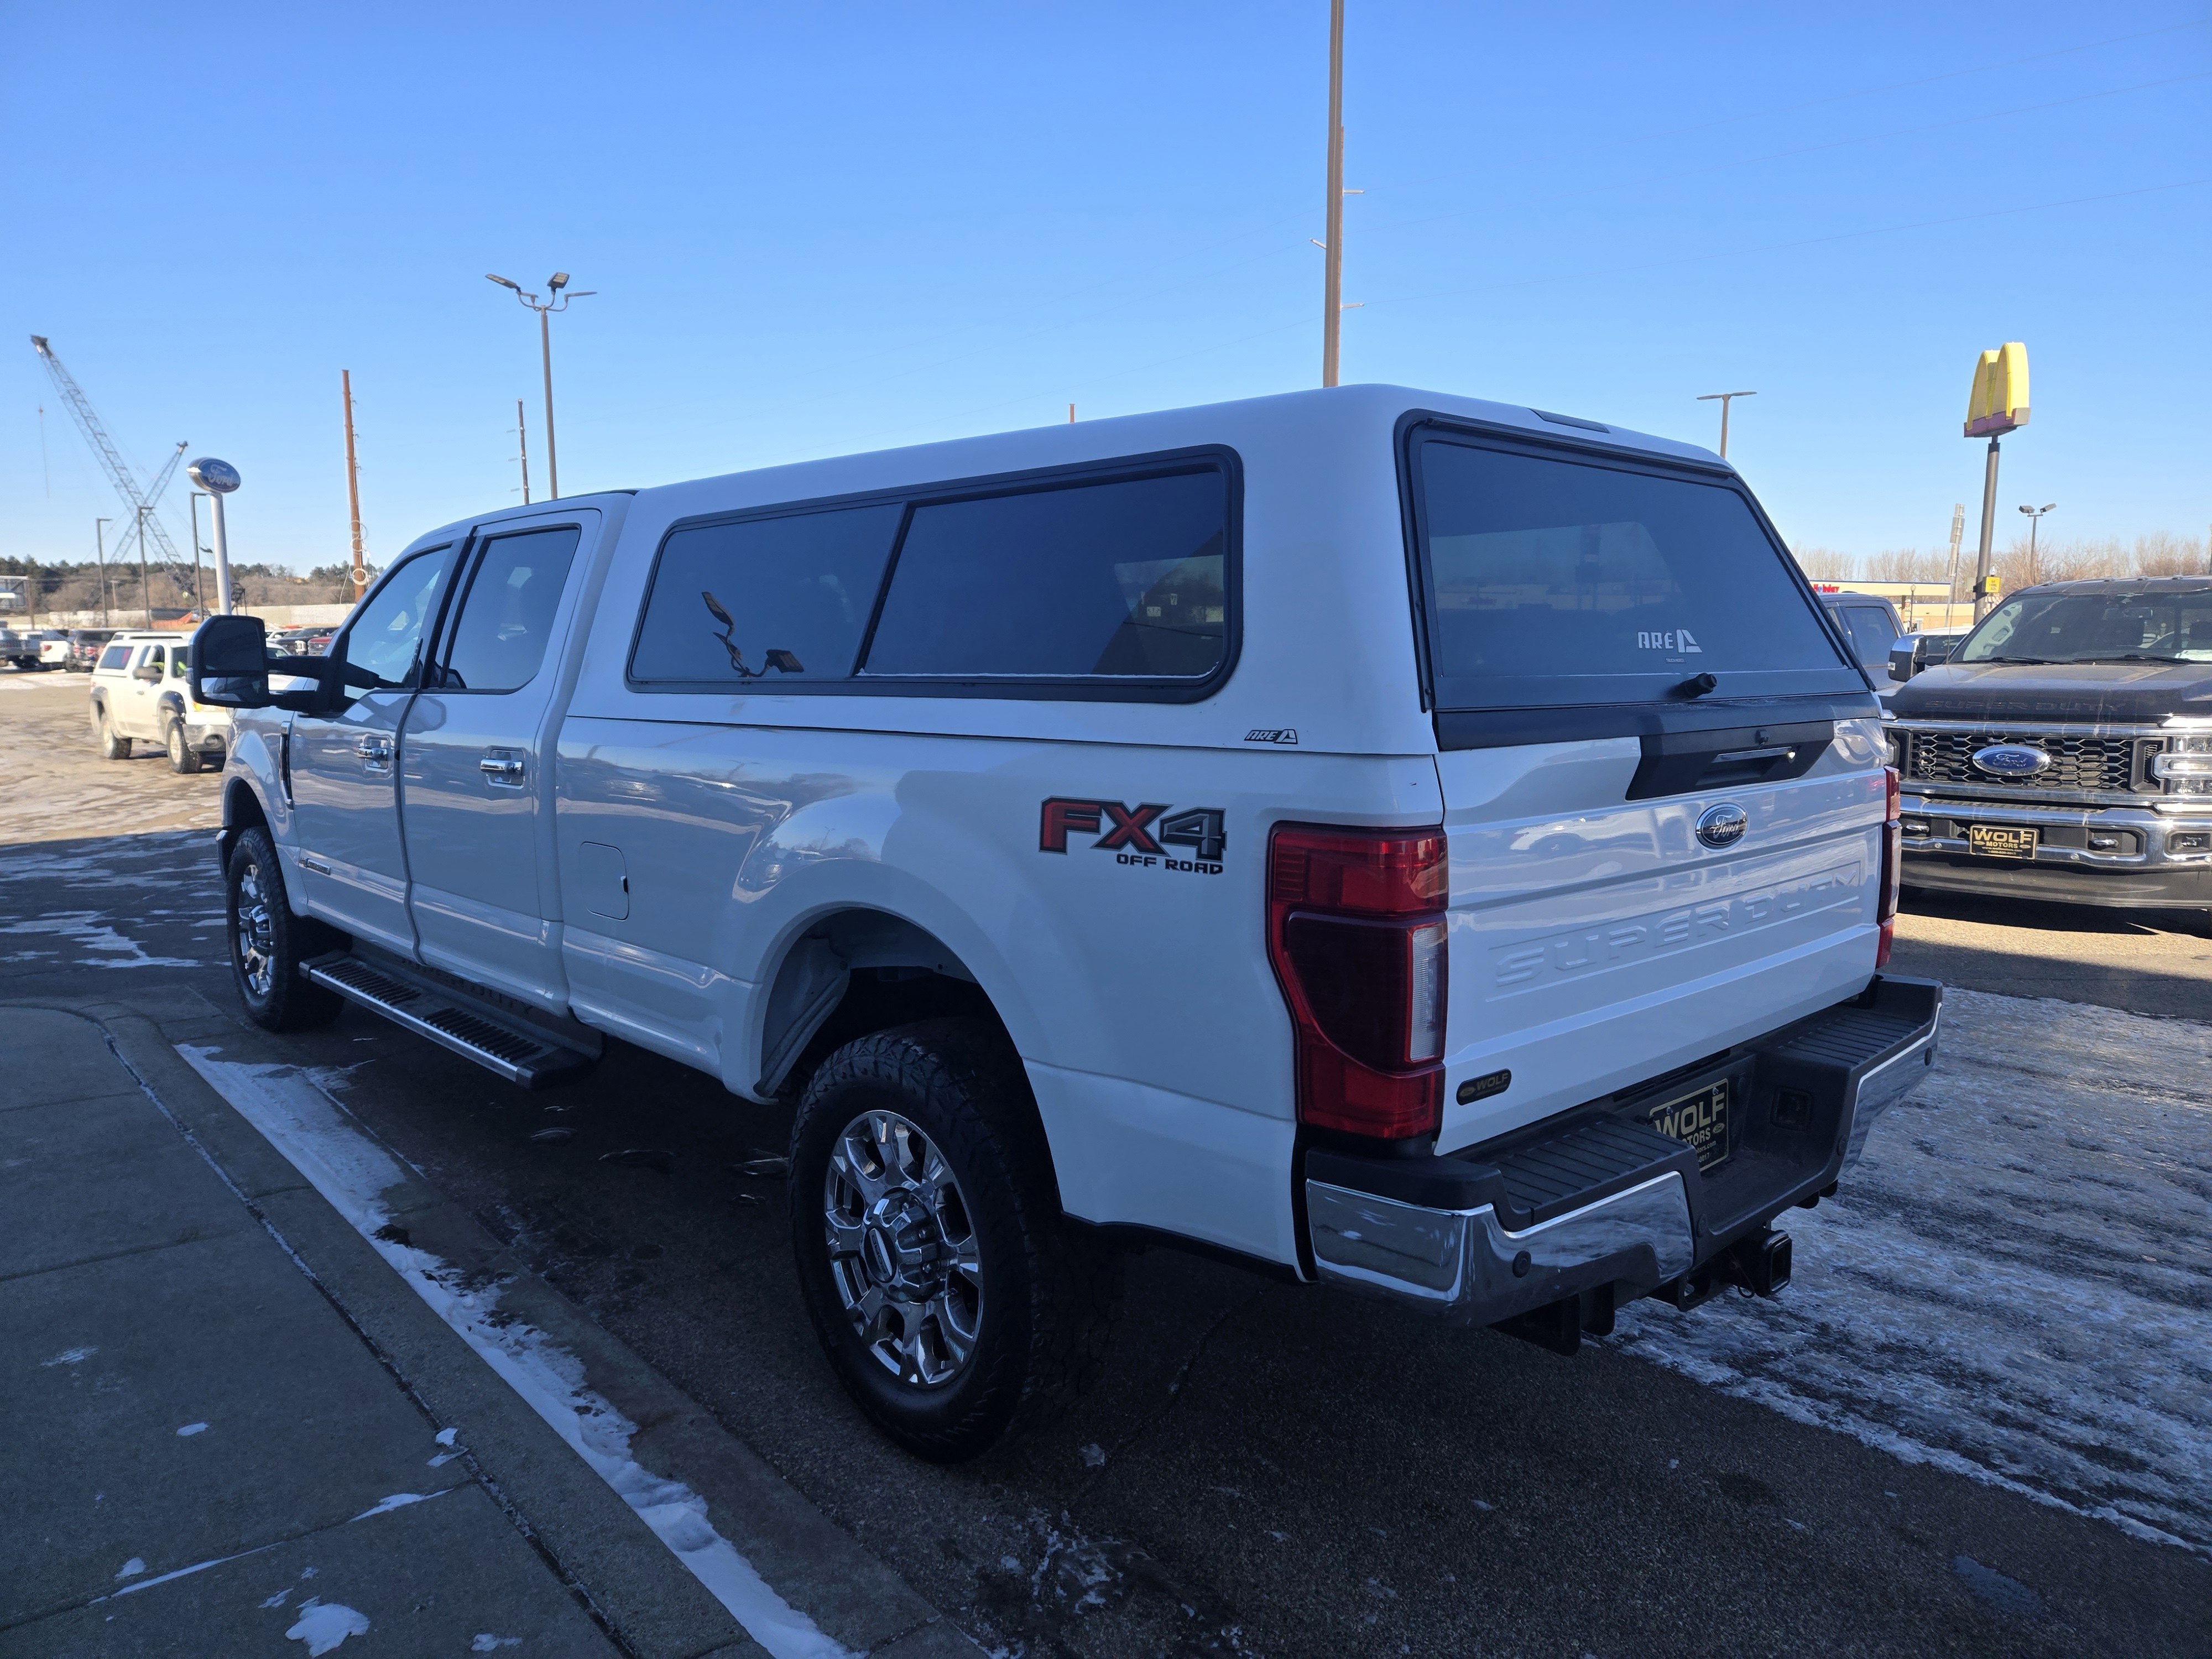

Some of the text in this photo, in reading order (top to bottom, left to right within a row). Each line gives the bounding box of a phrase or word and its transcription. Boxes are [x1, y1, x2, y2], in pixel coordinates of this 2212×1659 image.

[210, 464, 233, 487] Ford
[1992, 754, 2027, 767] Ford
[1039, 796, 1227, 863] FX4
[1709, 814, 1740, 839] Ford
[1974, 830, 2032, 844] WOLF
[1116, 853, 1224, 875] OFF ROAD
[1496, 906, 1730, 988] SUPER
[1477, 1073, 1509, 1091] WOLF
[1655, 1092, 1725, 1139] WOLF
[1682, 1127, 1711, 1146] TORS
